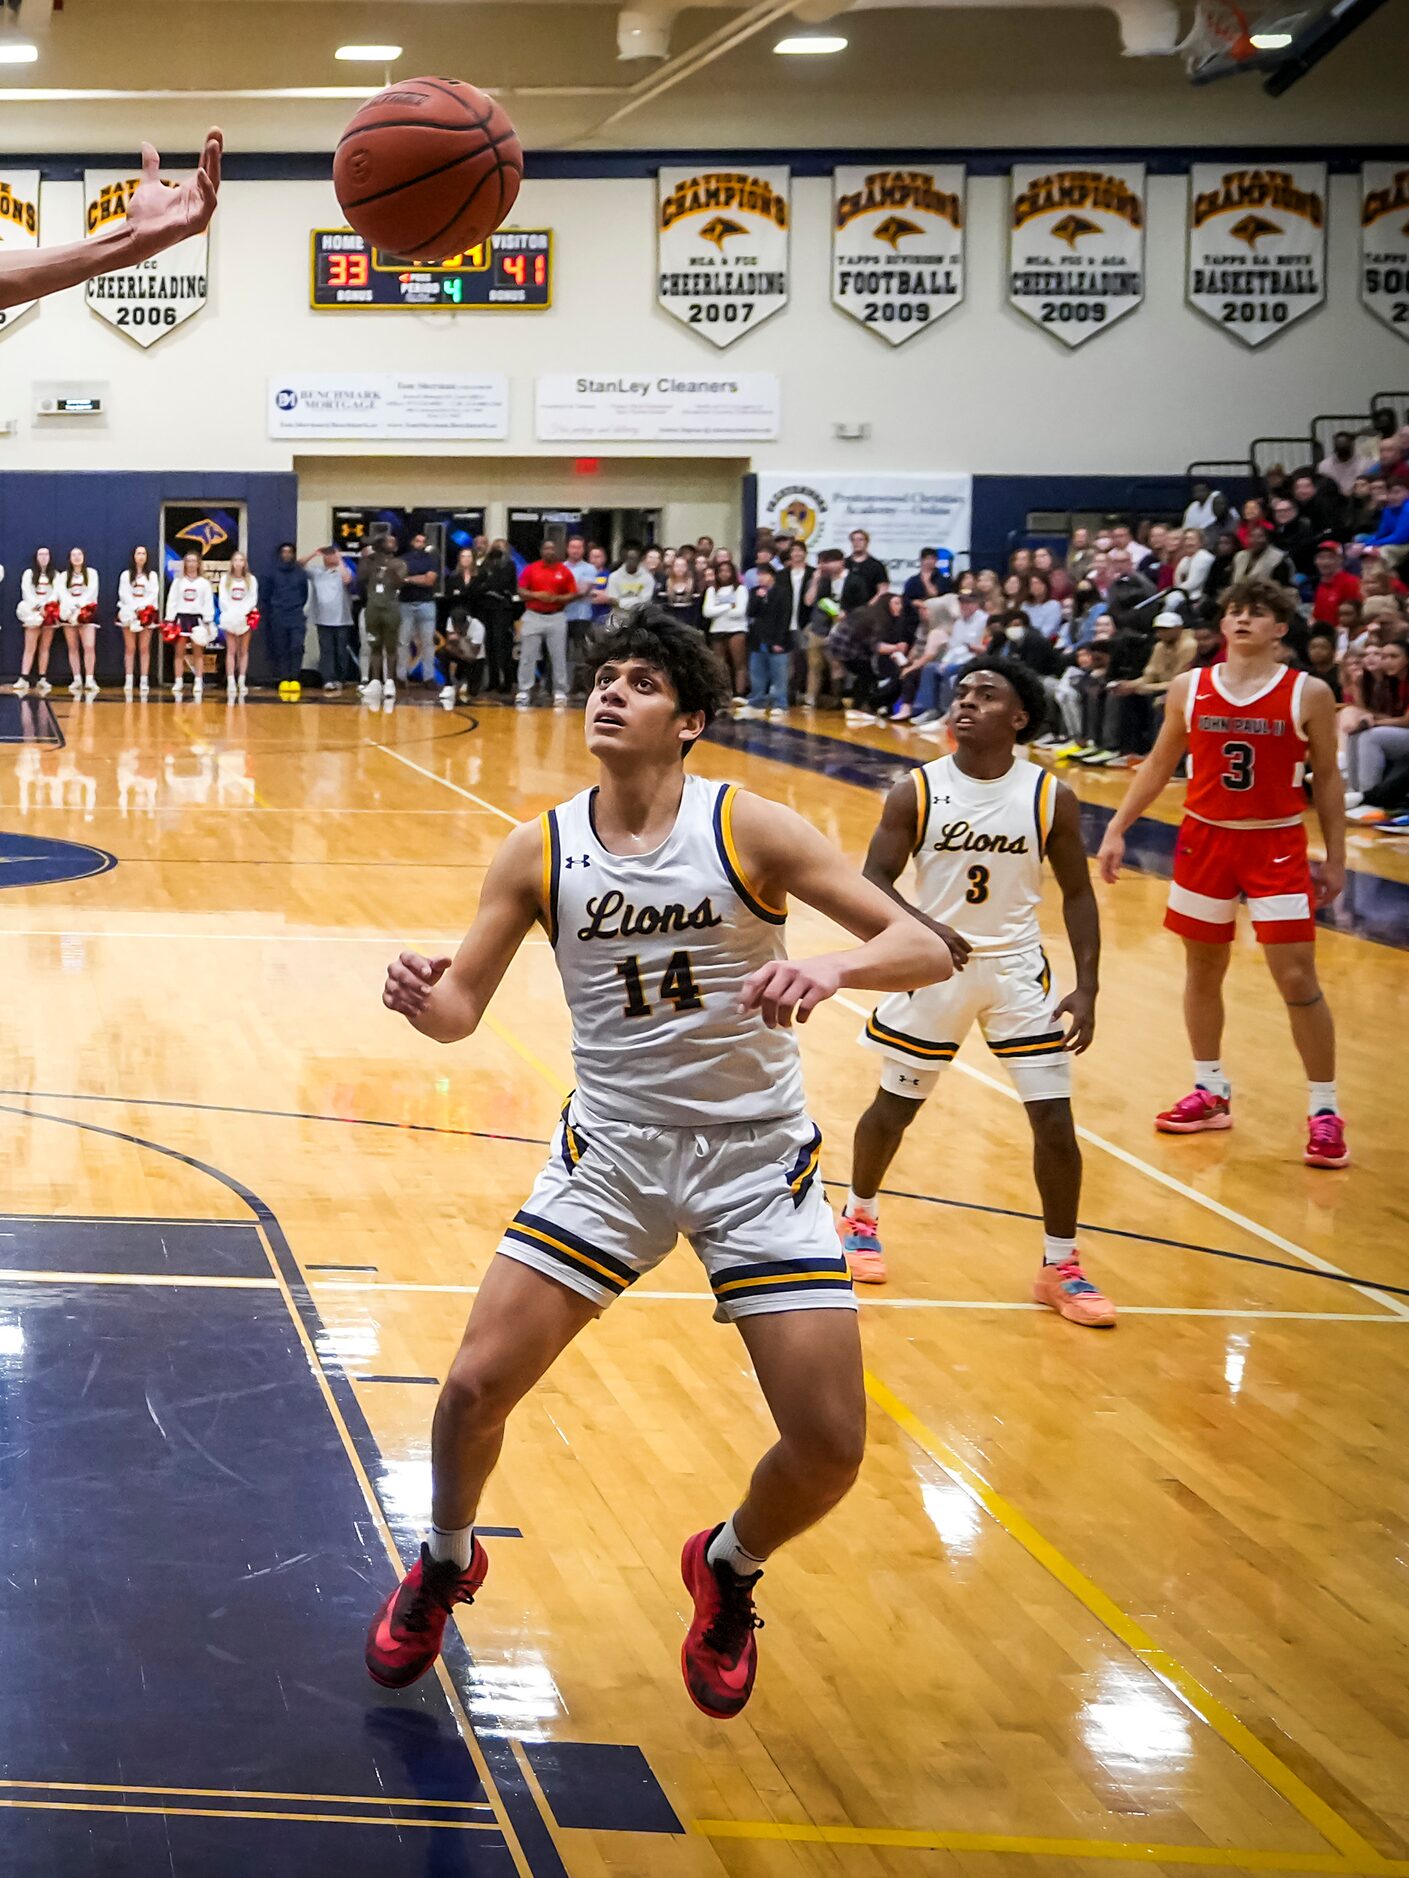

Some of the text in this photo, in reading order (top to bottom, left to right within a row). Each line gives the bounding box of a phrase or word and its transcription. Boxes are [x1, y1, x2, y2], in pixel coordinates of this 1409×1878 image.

[322, 235, 548, 250] HOME VISITOR
[329, 254, 369, 287] 33
[503, 254, 547, 286] 41
[838, 255, 880, 265] TAPPS
[88, 275, 207, 299] CHEERLEADING
[443, 278, 462, 303] 4
[661, 272, 785, 296] CHEERLEADING
[839, 271, 957, 295] FOOTBALL
[1012, 272, 1141, 296] CHEERLEADING
[1194, 270, 1319, 295] BASKETBALL
[117, 307, 176, 325] 2006
[689, 303, 754, 323] 2007
[864, 303, 930, 322] 2009
[1042, 302, 1107, 322] 2009
[1223, 303, 1289, 323] 2010
[300, 391, 381, 399] BENCHMARK
[576, 378, 738, 396] StanLey Cleaners
[305, 400, 376, 409] MORTGAGE
[1199, 715, 1229, 731] JOHN
[1233, 717, 1271, 734] PAUL
[1220, 740, 1256, 792] 3
[934, 821, 1029, 854] Lions
[965, 864, 990, 905] 3
[577, 890, 722, 941] Lions
[616, 950, 705, 1018] 14
